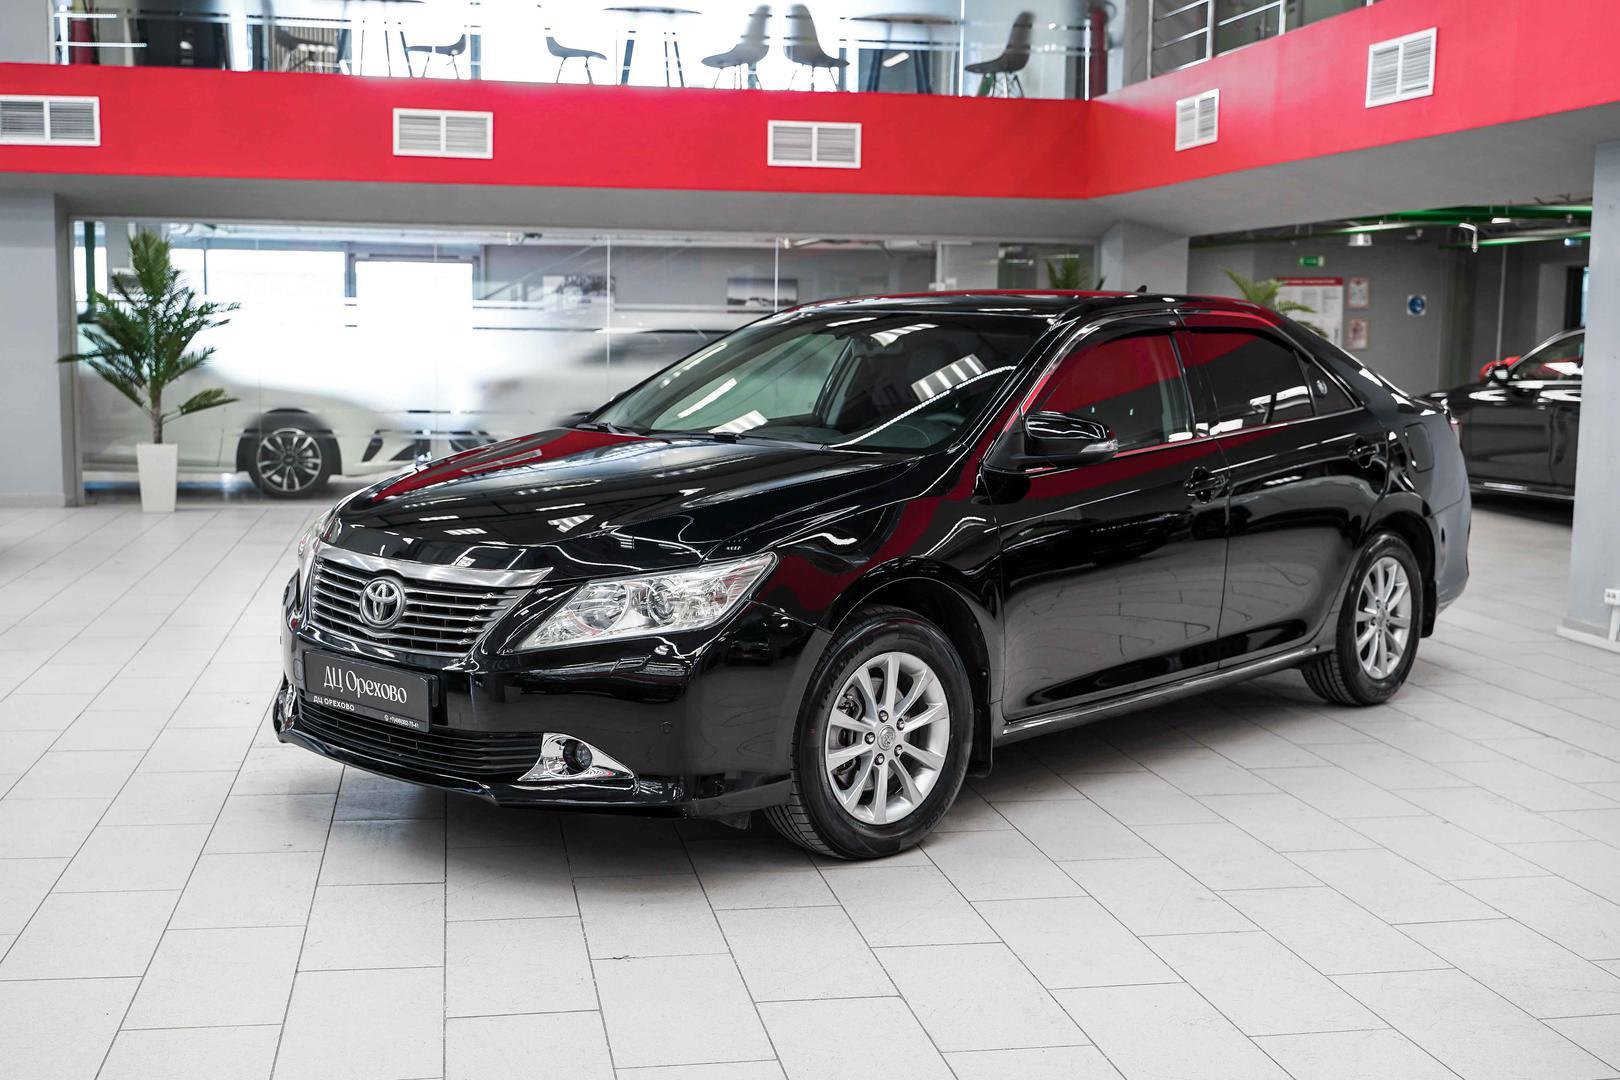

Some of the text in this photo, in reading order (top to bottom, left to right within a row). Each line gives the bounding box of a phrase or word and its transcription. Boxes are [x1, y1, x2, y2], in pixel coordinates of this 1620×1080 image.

[324, 666, 408, 704] ДЦ Орехово
[313, 696, 355, 711] ДЦ ОРЕХОВО
